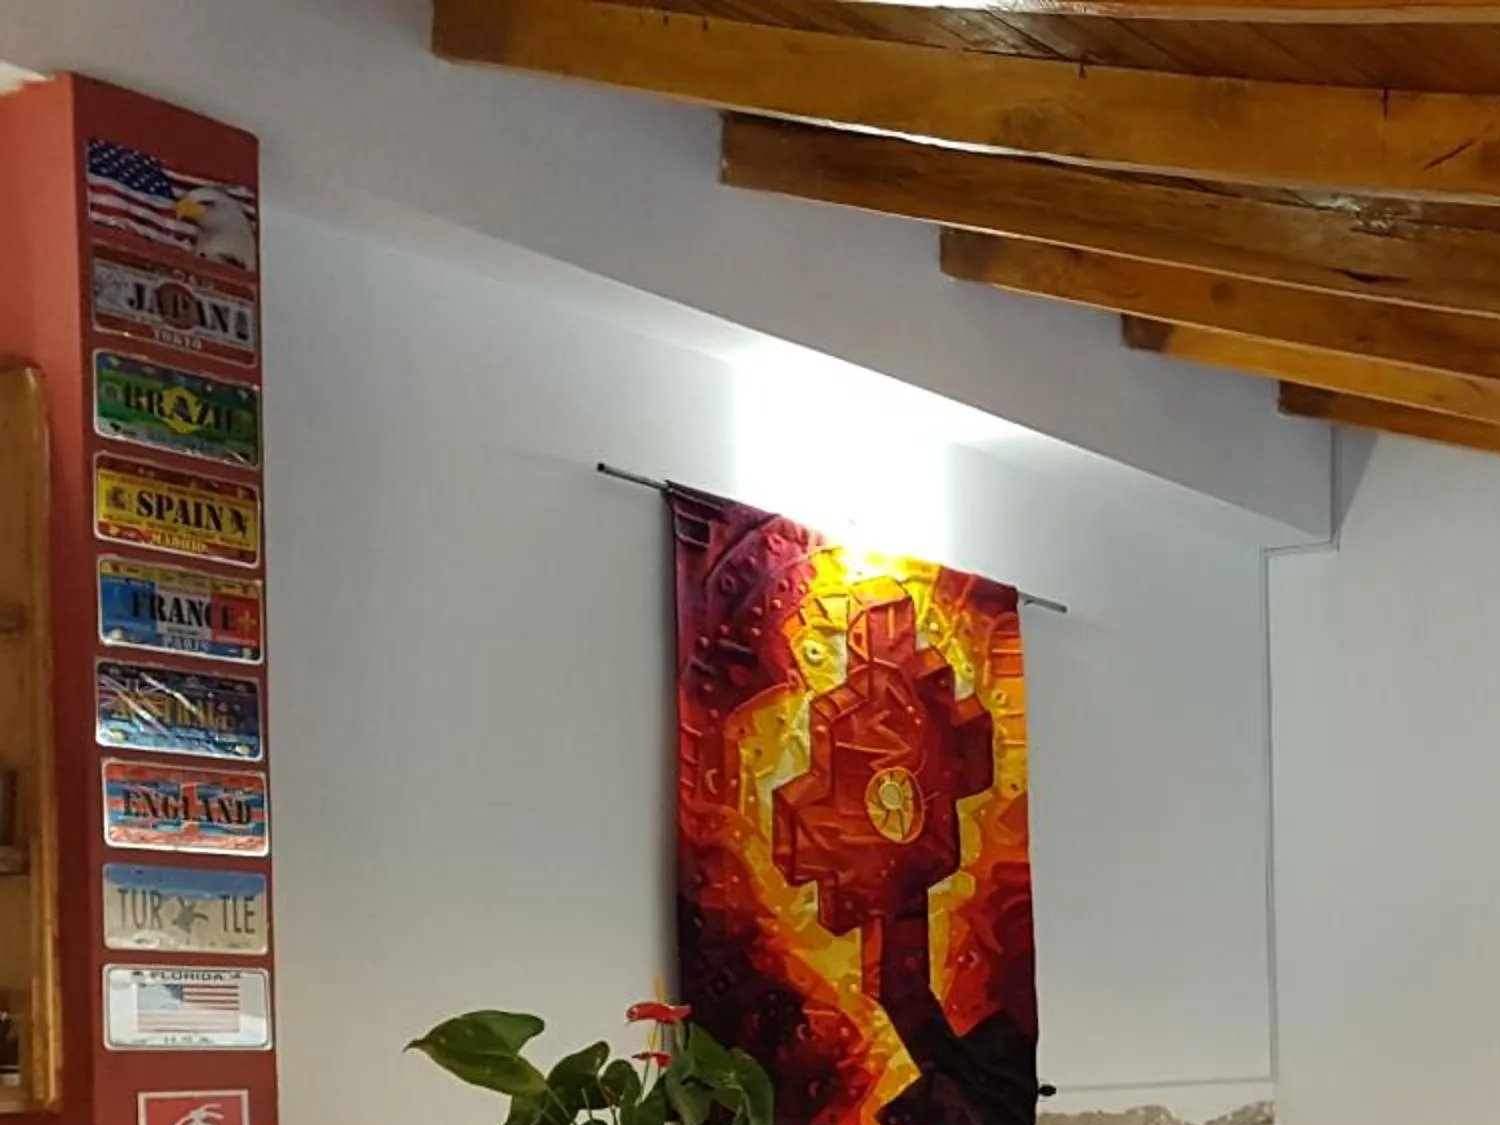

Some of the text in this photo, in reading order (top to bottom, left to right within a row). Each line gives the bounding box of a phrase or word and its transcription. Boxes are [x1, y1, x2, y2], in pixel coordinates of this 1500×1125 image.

[127, 282, 231, 335] JAPAN
[135, 489, 223, 532] SPAIN
[131, 591, 236, 631] FRANCE
[122, 789, 252, 826] ENGLAND
[116, 887, 256, 935] TUR TLE
